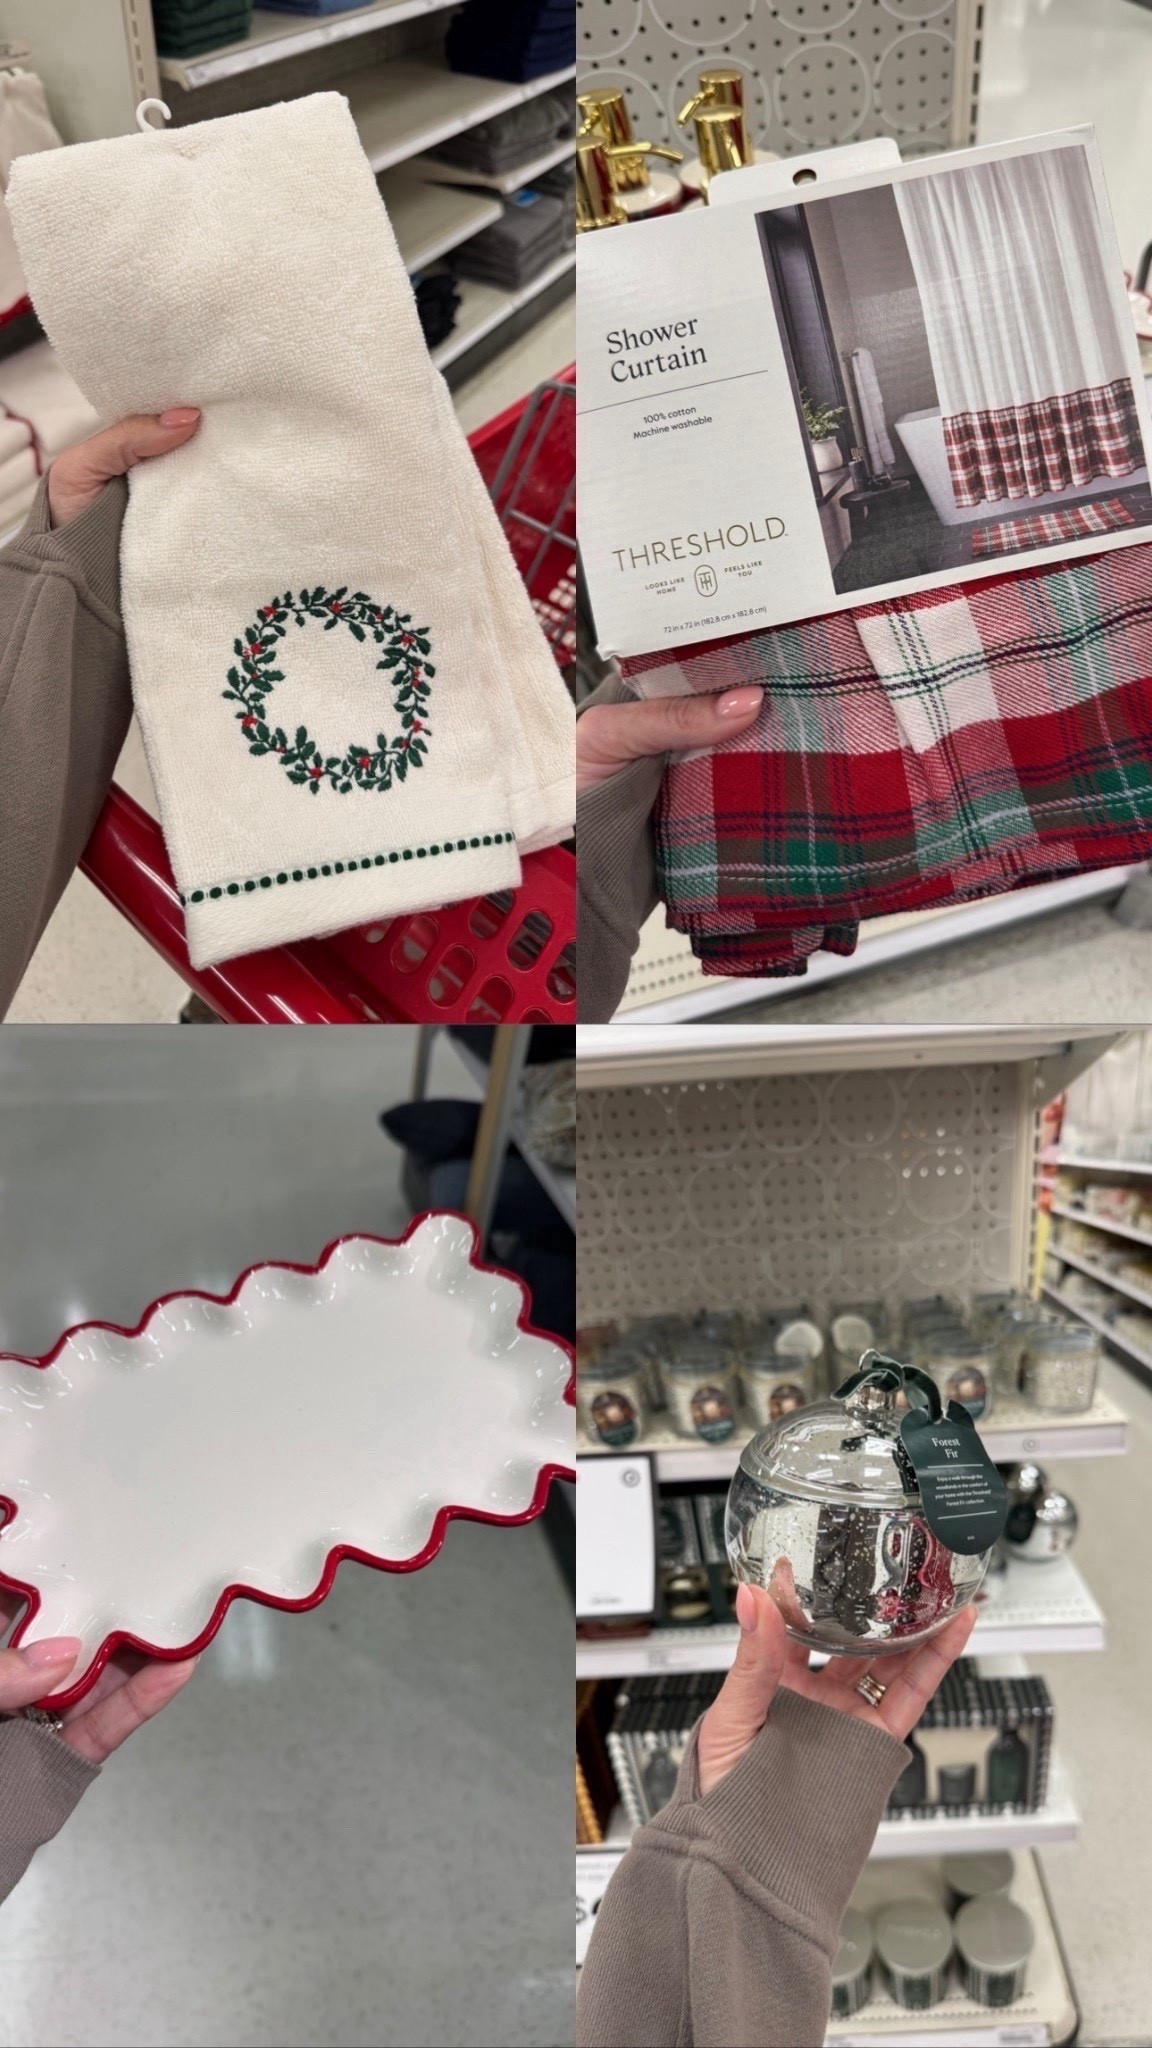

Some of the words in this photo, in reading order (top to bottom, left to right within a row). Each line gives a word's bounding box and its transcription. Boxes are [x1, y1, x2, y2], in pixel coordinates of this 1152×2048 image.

[606, 318, 698, 354] Shower
[610, 345, 707, 382] Curtain
[643, 412, 667, 424] 100%
[667, 406, 697, 419] cotton
[633, 426, 670, 439] Machine
[671, 416, 713, 430] washable
[724, 563, 745, 573] FEELS
[747, 560, 763, 569] LIKE
[737, 570, 753, 578] YOU
[645, 581, 668, 591] LOOKS
[670, 577, 685, 586] LIKE
[656, 586, 677, 595] HOME
[663, 626, 672, 634] 72
[672, 624, 680, 632] in
[684, 621, 693, 629] 72
[701, 615, 720, 626] (182.8
[736, 608, 755, 618] 182.8
[754, 606, 767, 614] cm)
[931, 1437, 961, 1447] Forest
[944, 1448, 959, 1459] Fir
